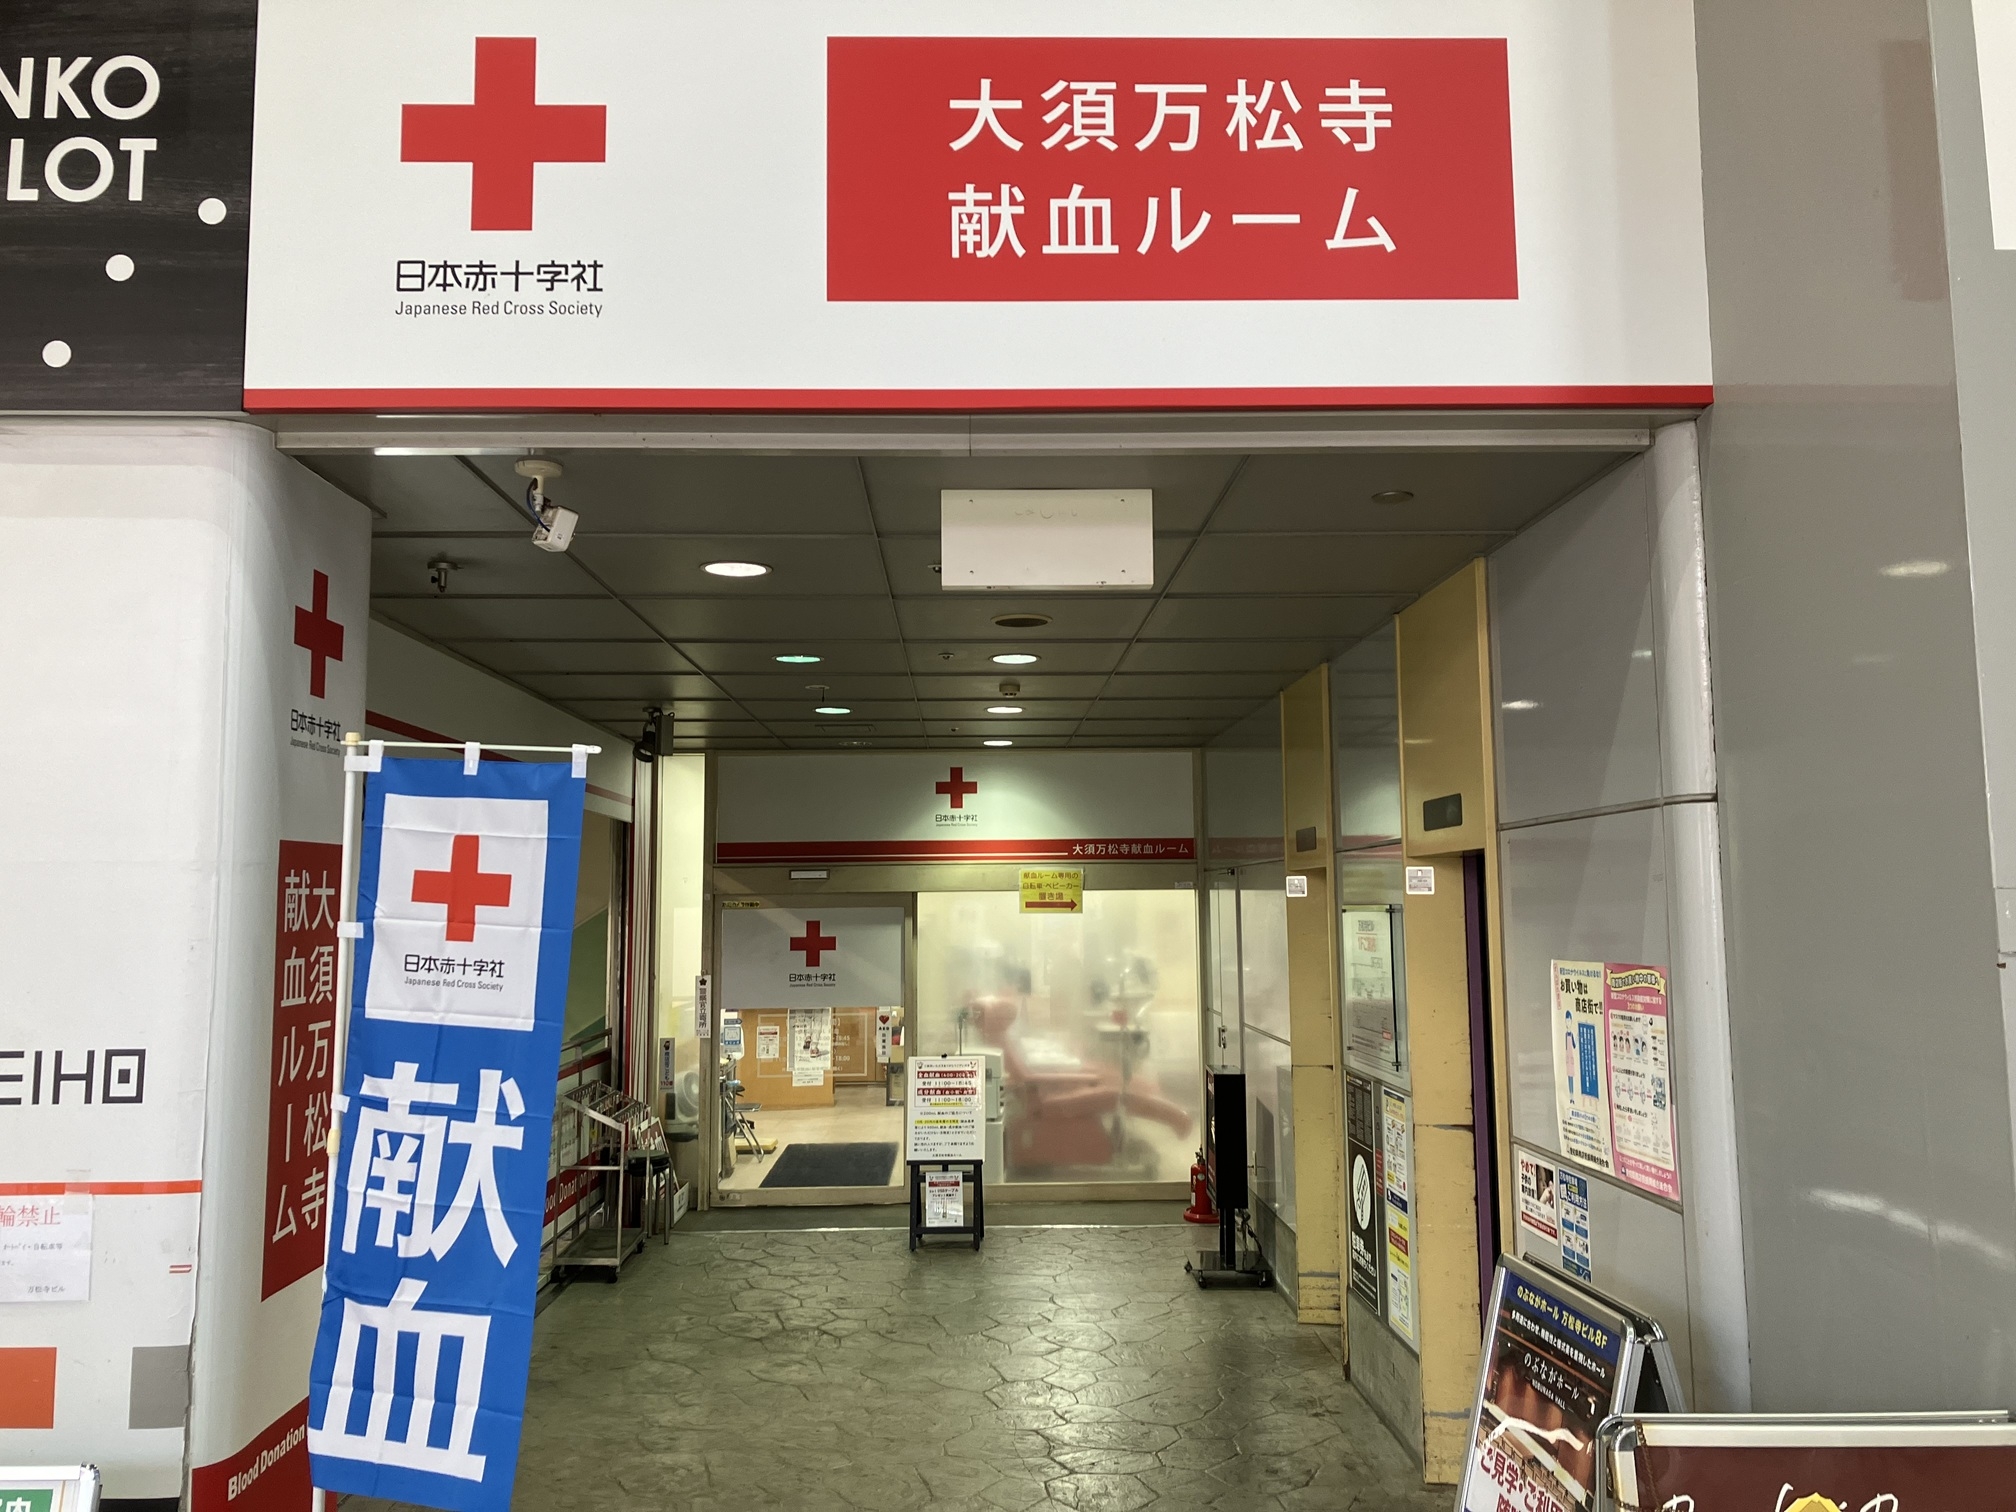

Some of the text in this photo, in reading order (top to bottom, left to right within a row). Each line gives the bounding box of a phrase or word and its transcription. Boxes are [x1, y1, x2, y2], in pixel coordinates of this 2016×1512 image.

[948, 78, 1393, 153] 大須万松寺
[6, 137, 158, 202] LOT
[947, 183, 1397, 259] 献血ルーム
[396, 260, 604, 292] 日本赤十字社
[395, 301, 603, 317] Japanese Red Cross Society
[291, 708, 341, 742] 日本赤十字社
[1072, 843, 1189, 855] 大須万松寺献血ルーム
[404, 954, 505, 978] 日本赤十字社
[404, 976, 504, 992] Japanese Red Cross Society
[789, 973, 836, 982] 日本赤十字社
[1561, 978, 1588, 996] お買い物は
[272, 869, 311, 1244] 献血ルーム
[301, 870, 336, 1231] 大須万松寺
[307, 1060, 526, 1484] 献血
[1517, 1285, 1608, 1350] のぶながホール 万松寺ビル8F
[1524, 1352, 1580, 1400] のぶながホール
[1554, 1395, 1566, 1411] HALL
[227, 1423, 306, 1502] Blood Donation
